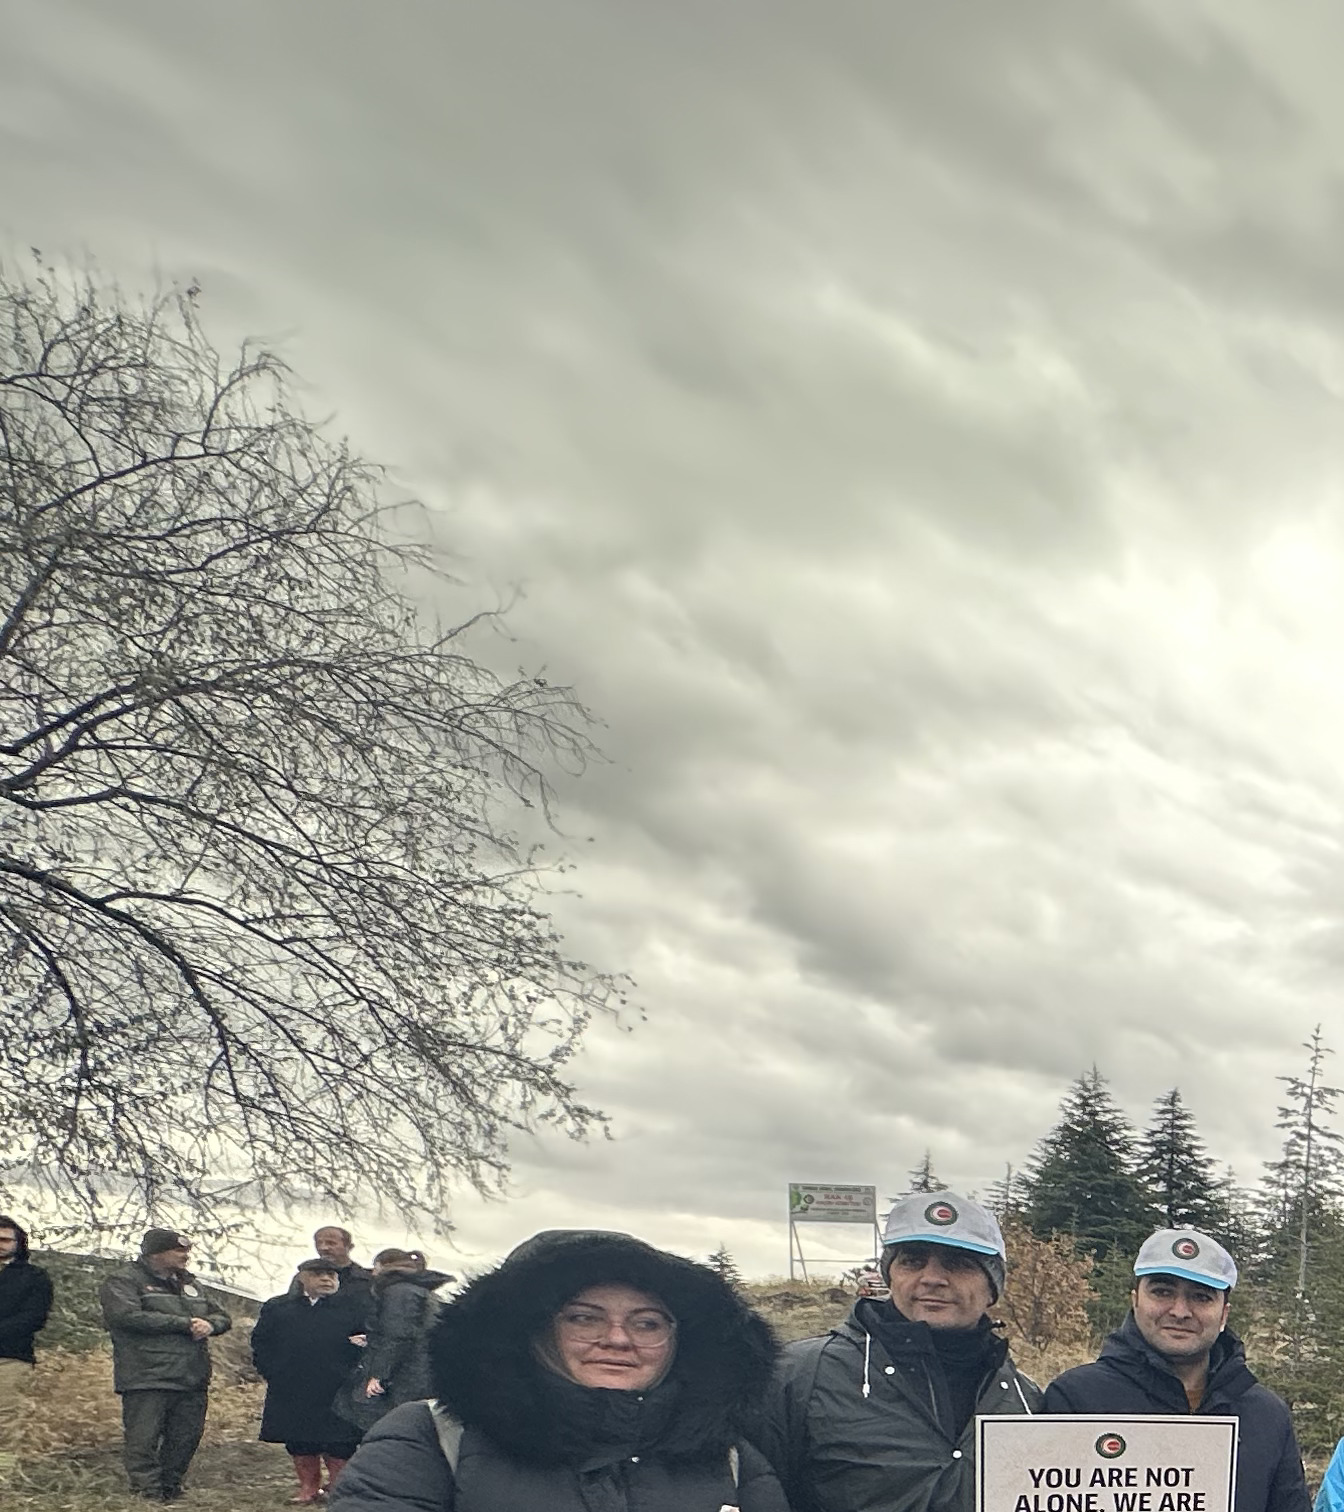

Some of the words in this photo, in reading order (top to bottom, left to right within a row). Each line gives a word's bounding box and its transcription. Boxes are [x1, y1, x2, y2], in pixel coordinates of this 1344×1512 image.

[1028, 1468, 1082, 1488] YOU
[1089, 1467, 1138, 1487] ARE
[1146, 1467, 1195, 1487] NOT
[1114, 1493, 1152, 1512] WE
[1159, 1492, 1206, 1512] ARE
